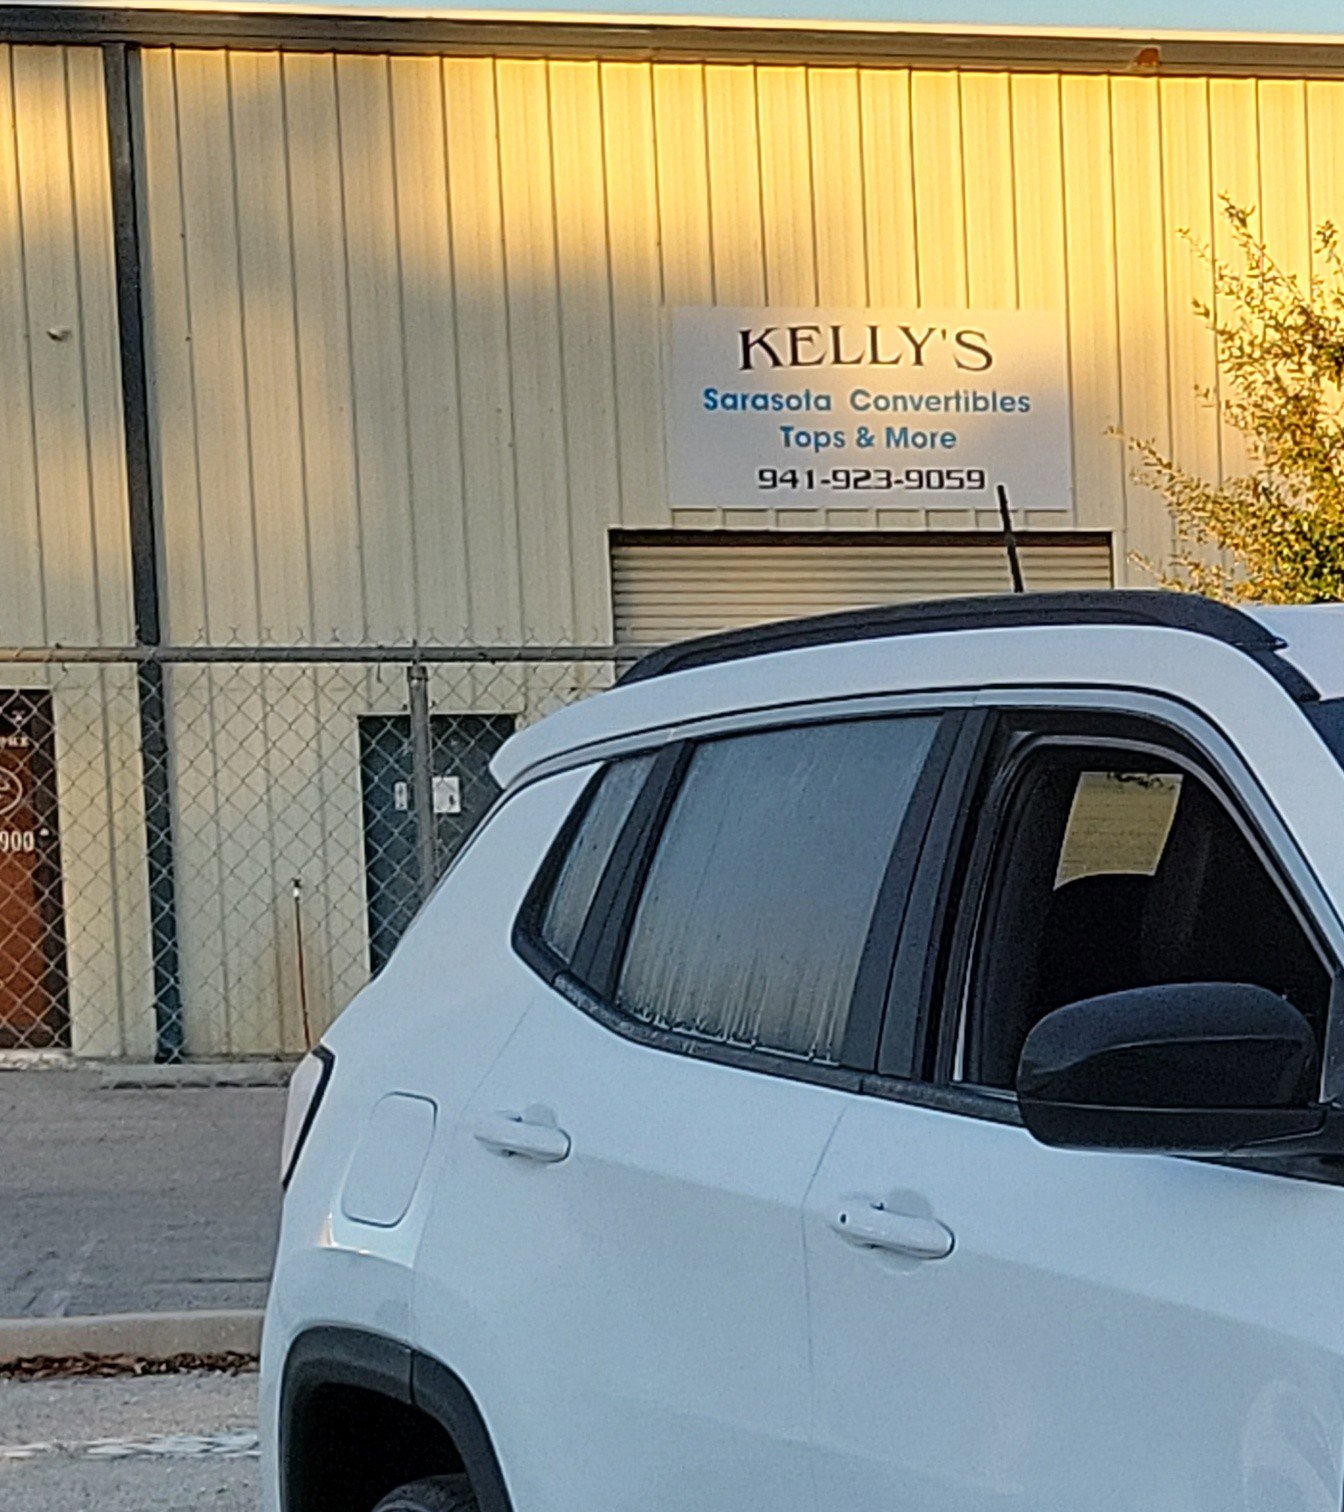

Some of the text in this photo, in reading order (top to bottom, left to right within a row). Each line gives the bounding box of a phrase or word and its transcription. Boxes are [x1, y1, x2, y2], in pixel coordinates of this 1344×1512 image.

[738, 325, 993, 371] KELLY'S
[703, 388, 1031, 413] Sarasota Convertibles
[780, 426, 957, 452] Tops & More
[758, 469, 987, 491] 941-923-9059
